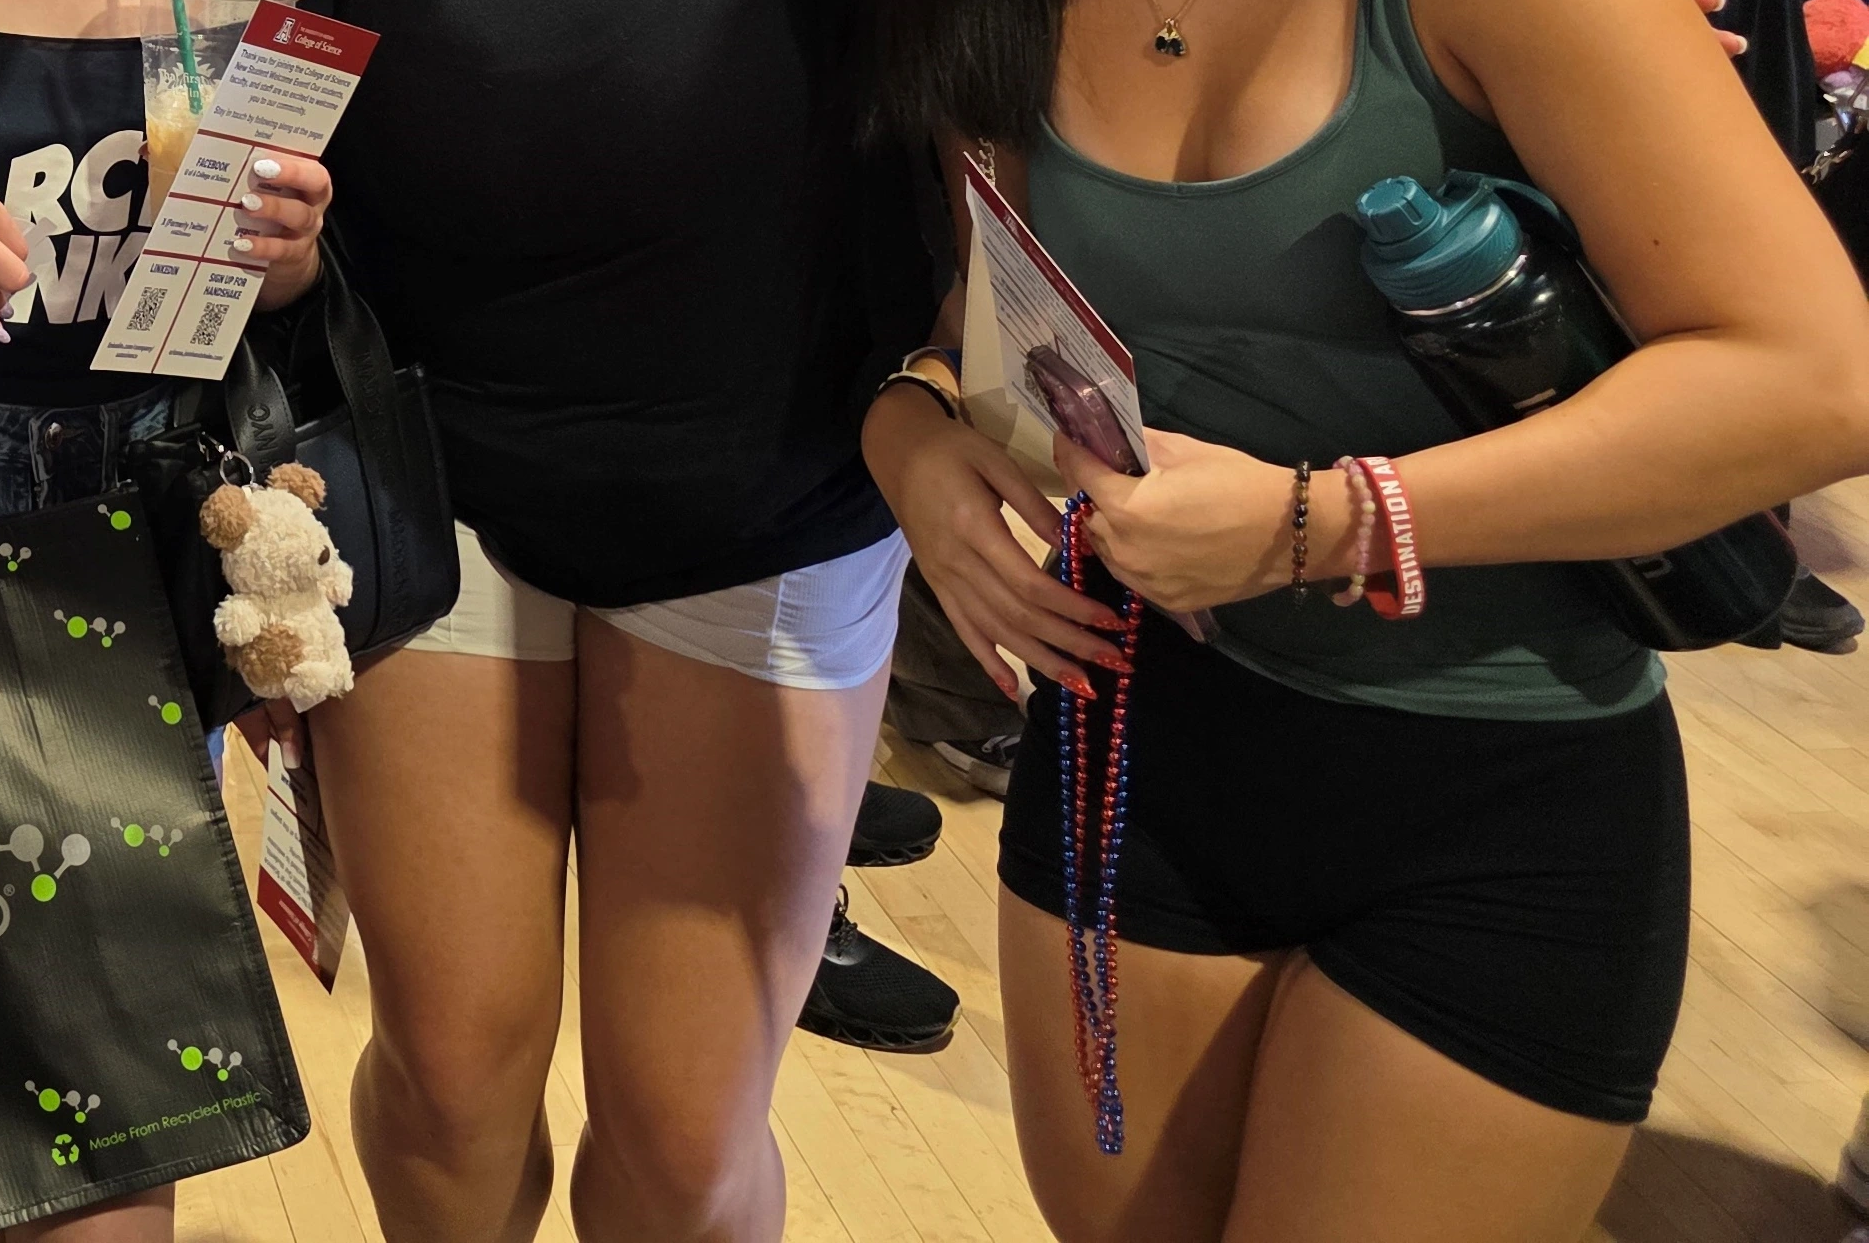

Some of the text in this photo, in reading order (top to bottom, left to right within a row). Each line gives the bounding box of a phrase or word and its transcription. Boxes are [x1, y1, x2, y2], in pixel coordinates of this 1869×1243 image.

[273, 17, 296, 45] A
[294, 33, 343, 56] College of Science
[208, 272, 248, 288] SIGN UP FOR
[1378, 479, 1424, 615] DESTINATION
[88, 1090, 262, 1151] Made From Recycled Plastic
